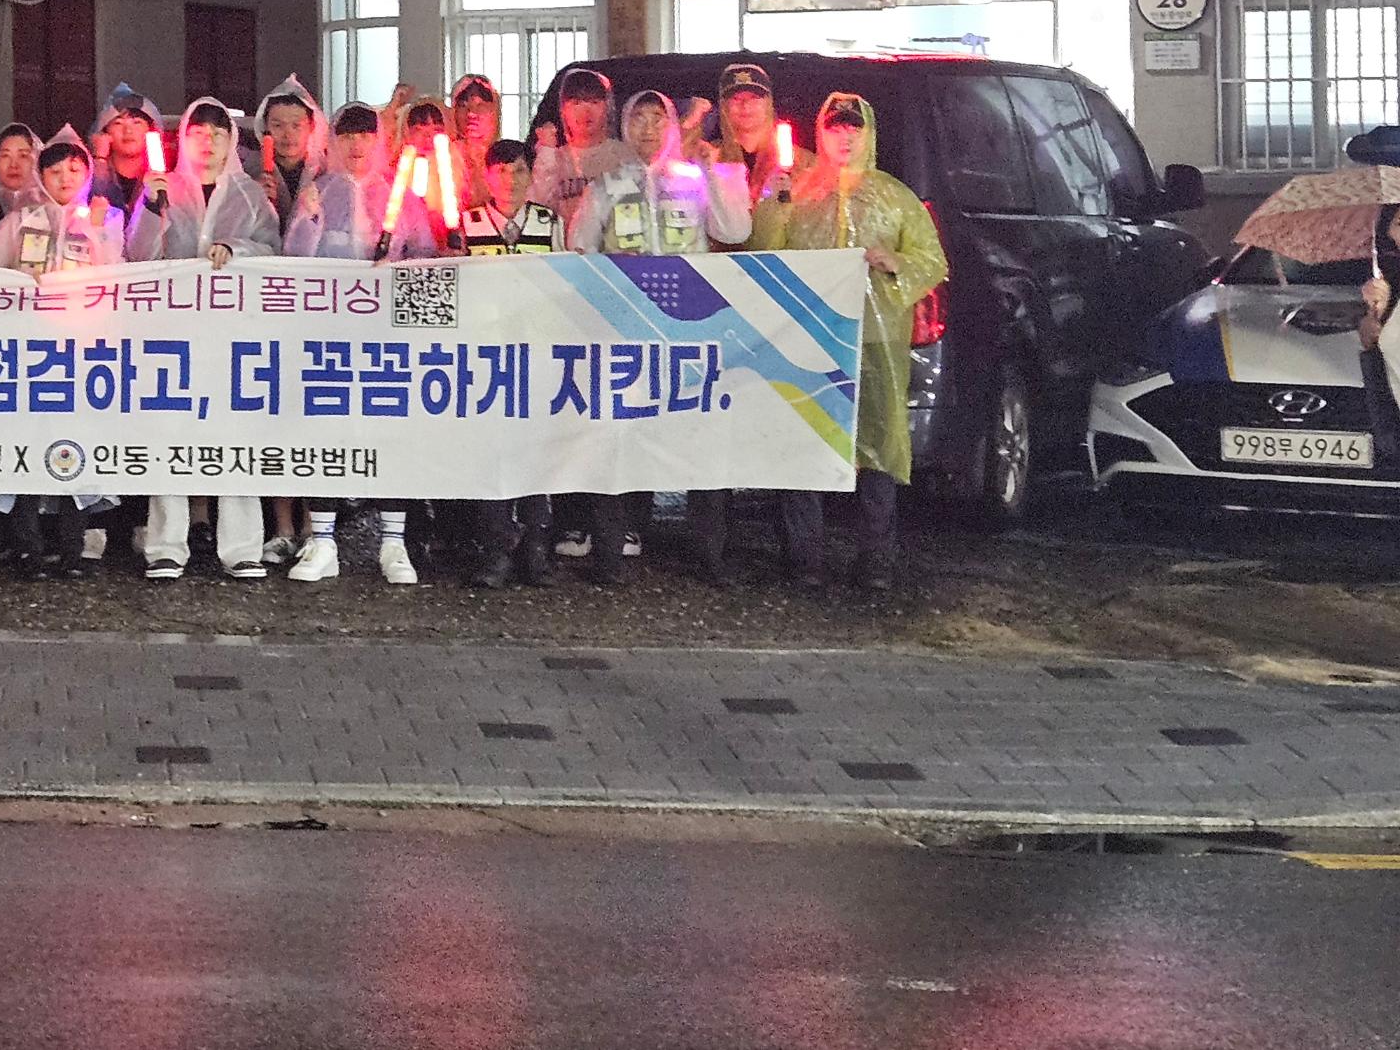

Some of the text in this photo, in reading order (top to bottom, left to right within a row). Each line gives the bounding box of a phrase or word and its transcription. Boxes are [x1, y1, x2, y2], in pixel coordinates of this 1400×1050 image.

[82, 275, 246, 314] 커뮤니티
[260, 274, 382, 316] 폴리싱
[231, 341, 281, 417] 더
[301, 341, 531, 420] 꼼꼼하게
[550, 343, 733, 421] 지킨다.
[14, 446, 31, 475] X
[1233, 434, 1361, 461] 998무 6946
